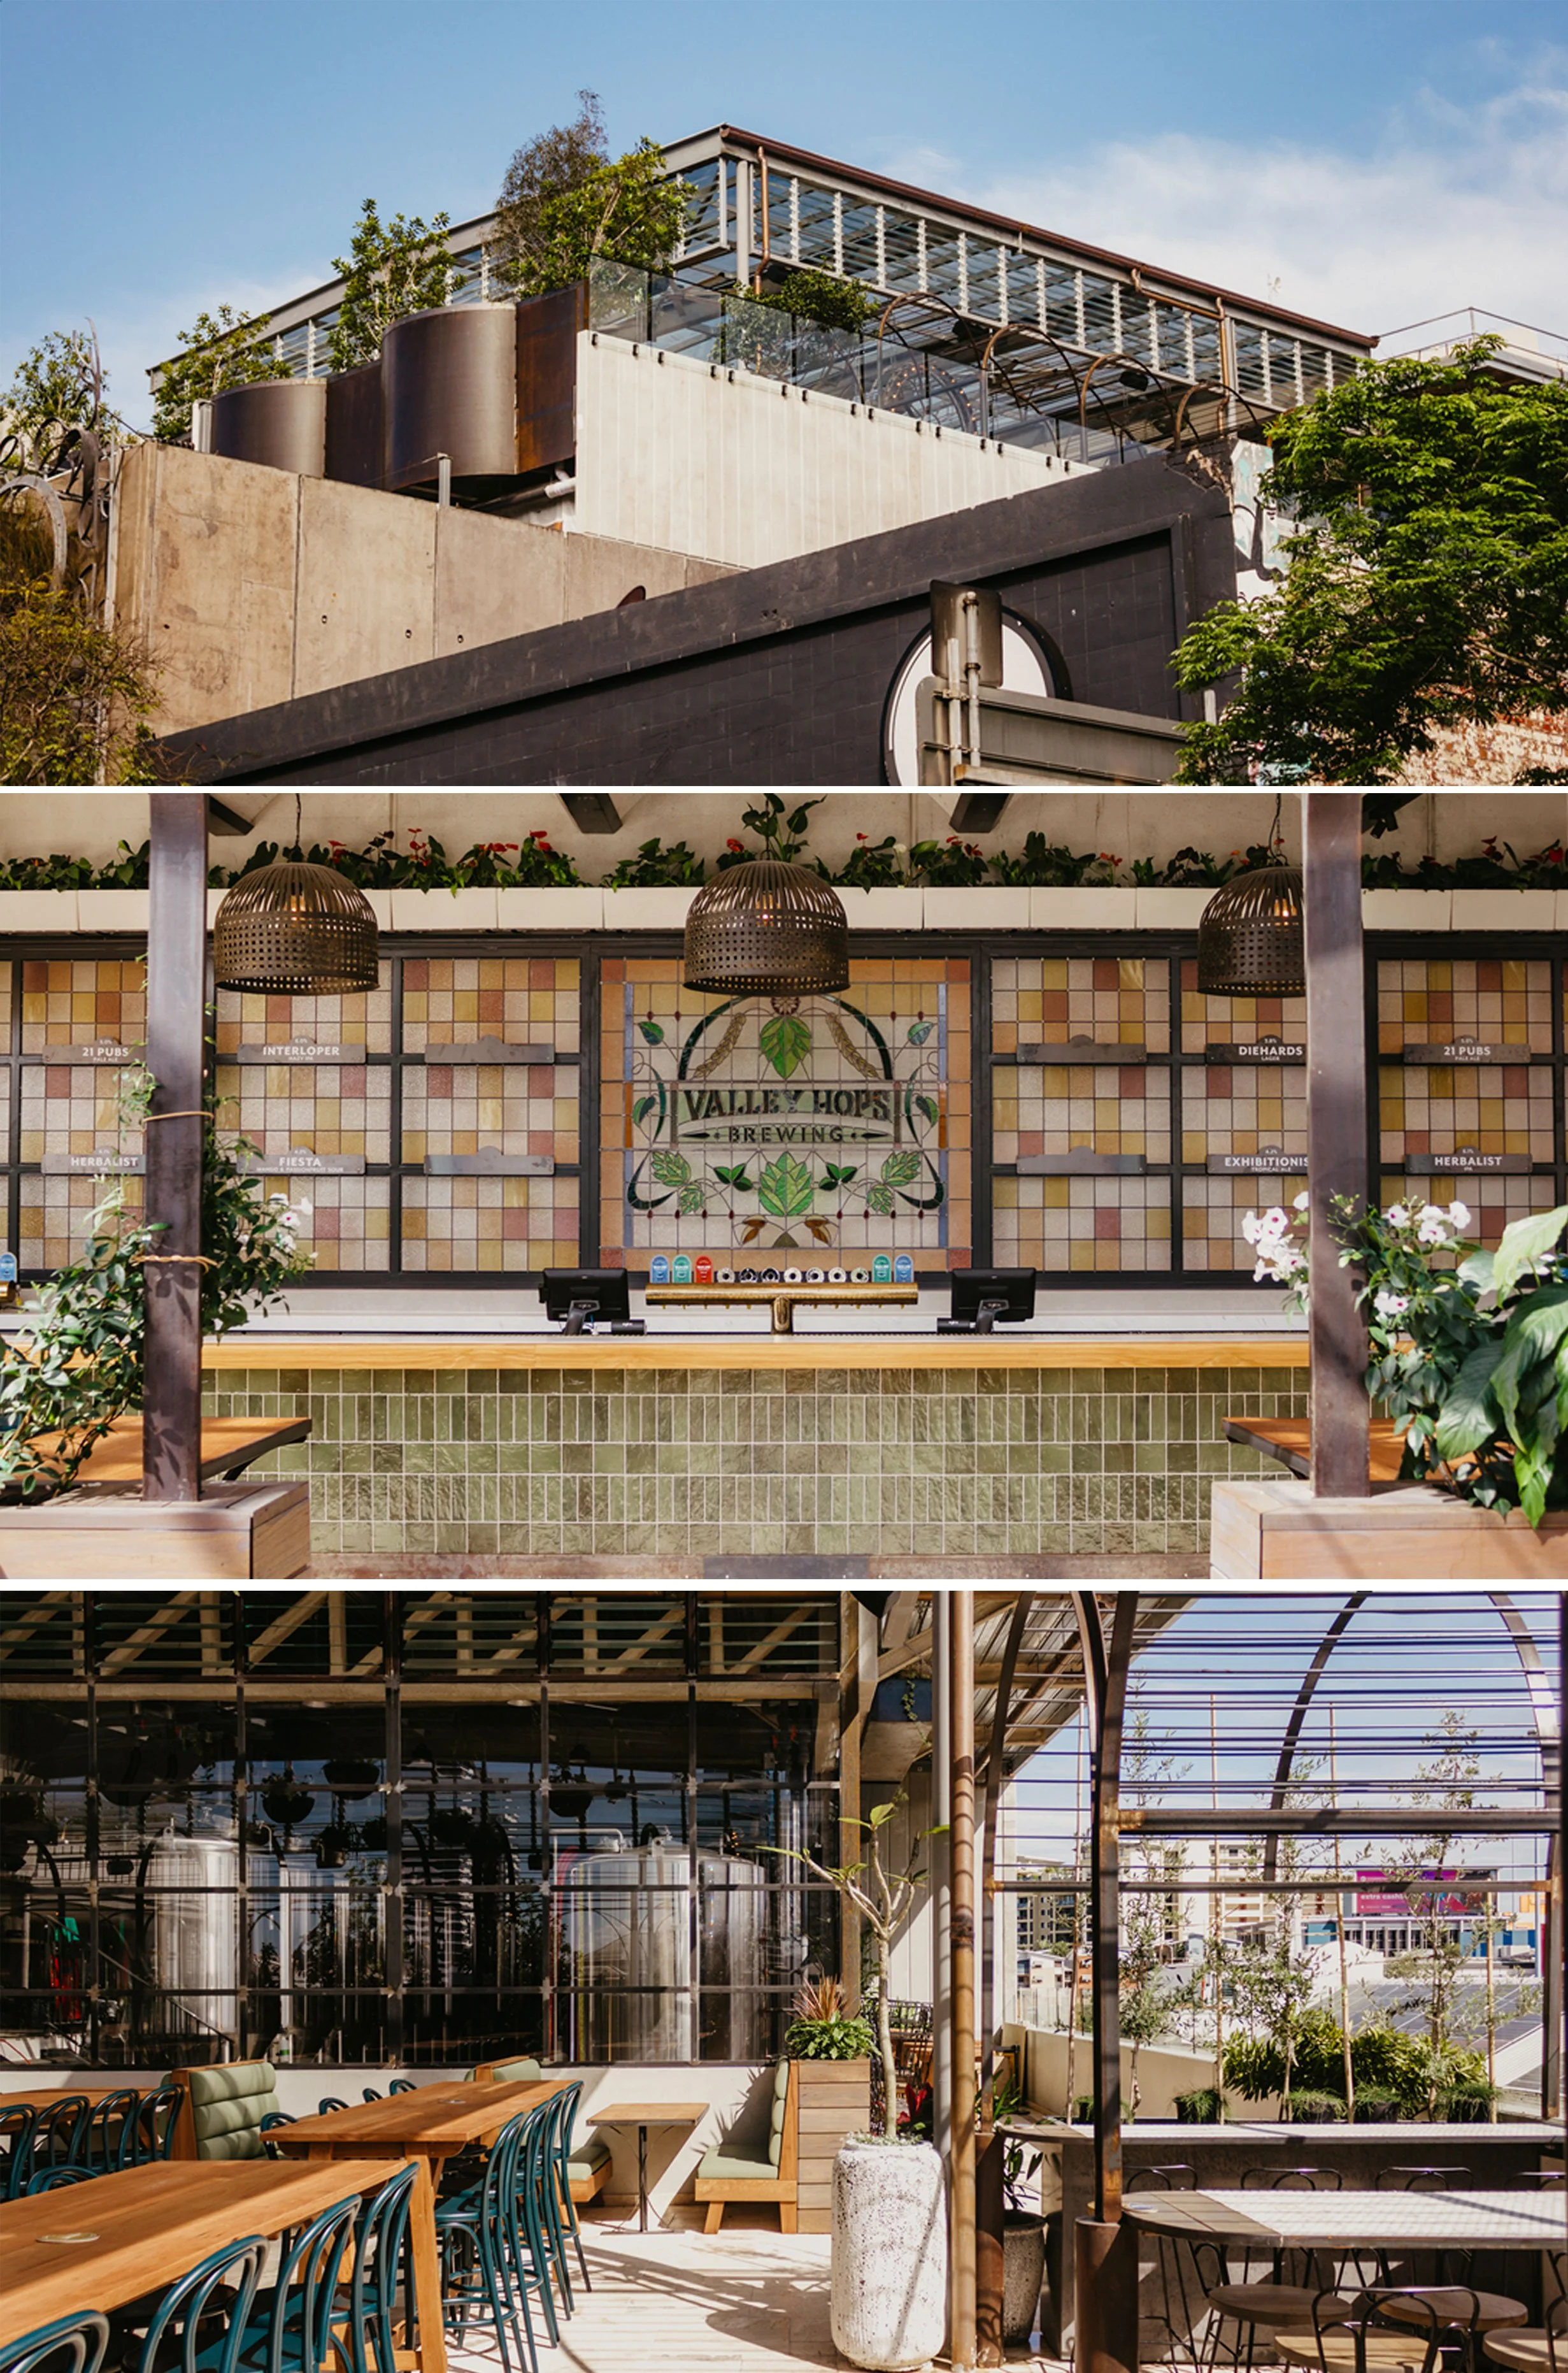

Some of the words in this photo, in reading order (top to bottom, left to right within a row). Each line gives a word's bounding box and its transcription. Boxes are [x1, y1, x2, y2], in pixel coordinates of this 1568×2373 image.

[82, 1047, 94, 1057] 21
[97, 1047, 129, 1057] PUBS
[262, 1046, 340, 1056] INTERLOPER
[1239, 1046, 1303, 1056] DIEHARDS
[1443, 1046, 1455, 1056] 21
[1458, 1046, 1492, 1056] PUBS
[683, 1090, 804, 1121] VALLEY
[813, 1090, 892, 1121] HOPS
[728, 1126, 844, 1143] BREWING
[71, 1157, 138, 1166] HERBALIST
[279, 1157, 322, 1166] FIESTA
[1225, 1157, 1309, 1166] EXHIBITIONIS
[1434, 1157, 1502, 1166] HERBALIST
